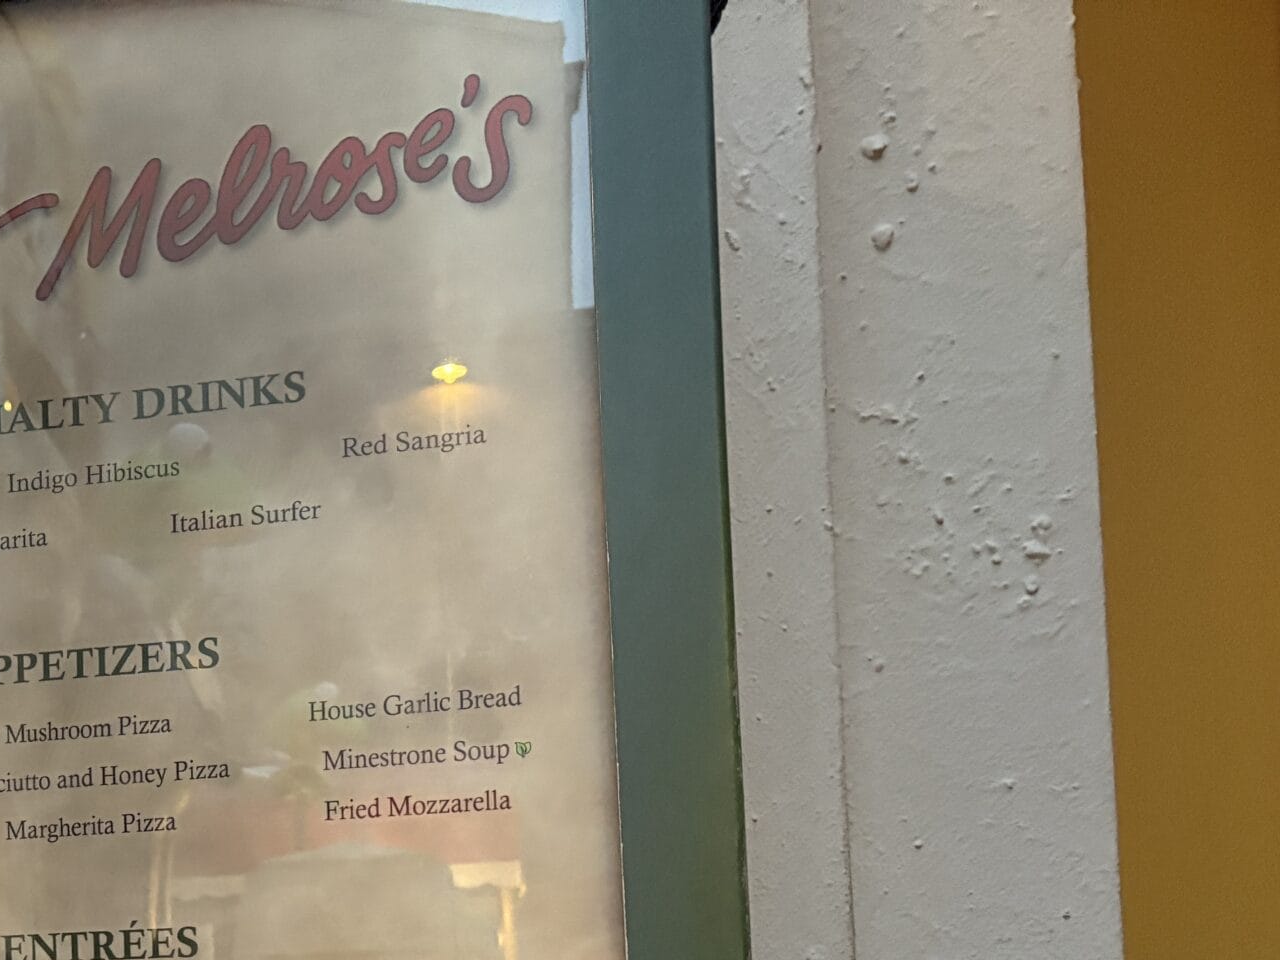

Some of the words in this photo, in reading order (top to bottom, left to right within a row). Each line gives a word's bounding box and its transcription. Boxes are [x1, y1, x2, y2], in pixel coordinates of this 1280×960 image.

[35, 74, 533, 301] Melrose's
[132, 370, 306, 420] DRINKS
[342, 433, 388, 458] Red
[396, 424, 487, 453] Sangria
[7, 469, 78, 494] Indigo
[84, 460, 180, 485] Hibiscus
[171, 509, 244, 533] Italian
[251, 500, 322, 526] Surfer
[308, 700, 377, 722] House
[383, 691, 451, 716] Garlic
[457, 685, 522, 711] Bread
[5, 721, 113, 744] Mushroom
[118, 714, 172, 736] Pizza
[322, 748, 446, 771] Minestrone
[453, 740, 510, 765] Soup
[57, 767, 94, 789] and
[100, 765, 168, 788] Honey
[173, 759, 231, 782] Pizza
[324, 797, 382, 821] Fried
[387, 789, 512, 817] Mozzarella
[5, 815, 115, 843] Margherita
[121, 812, 177, 834] Pizza
